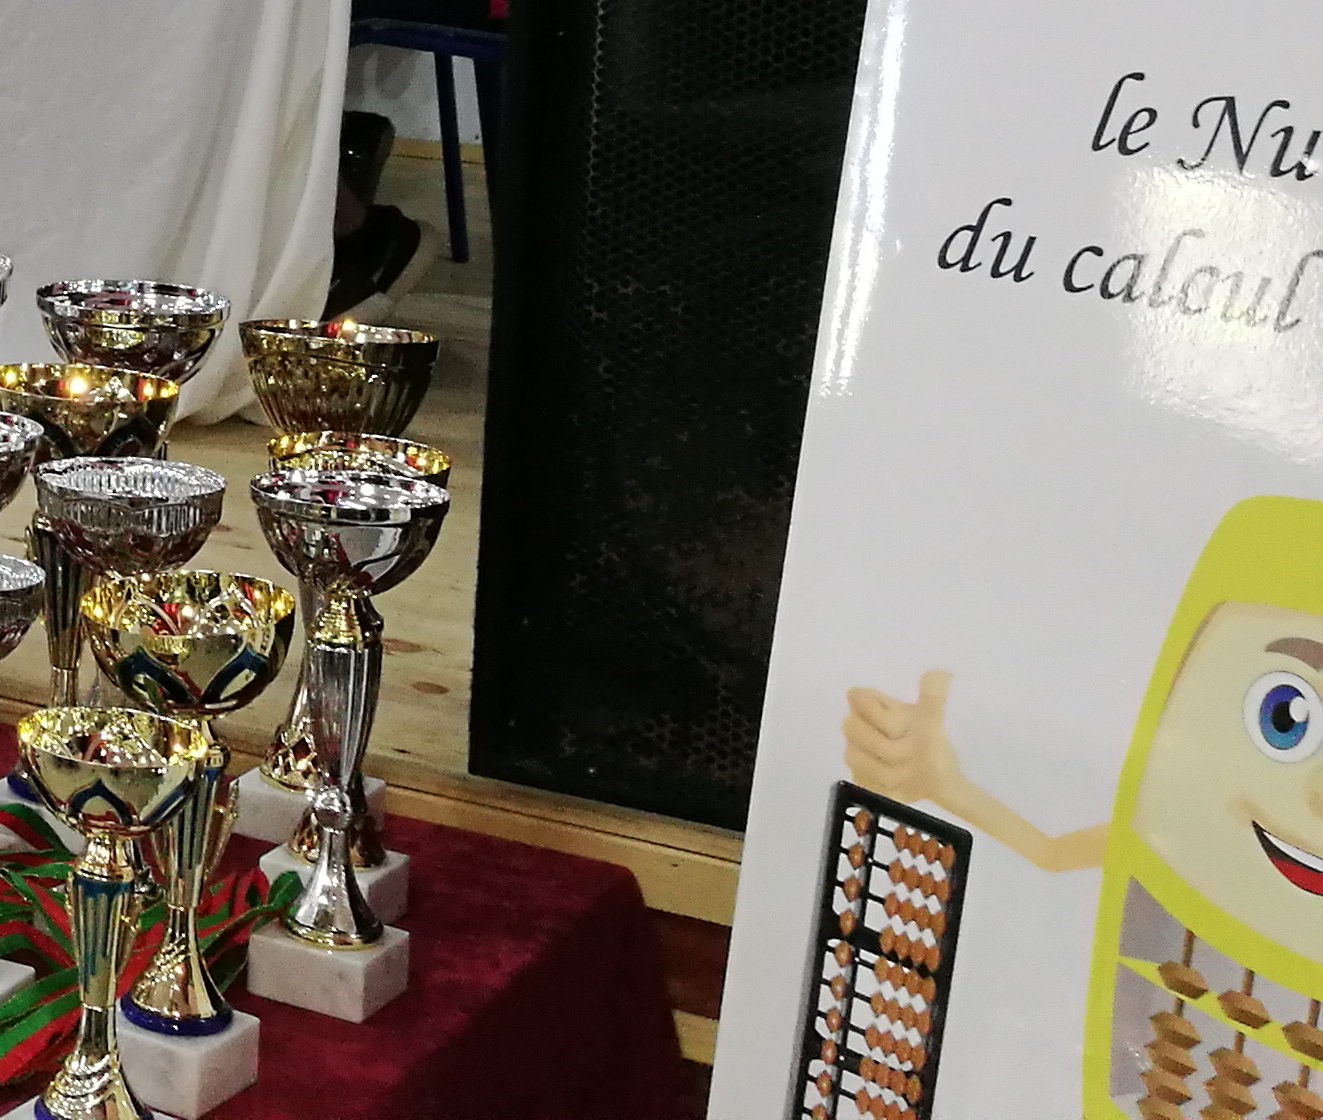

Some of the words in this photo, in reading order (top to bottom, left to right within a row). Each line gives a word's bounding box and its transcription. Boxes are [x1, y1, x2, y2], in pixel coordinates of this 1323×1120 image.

[1091, 71, 1158, 156] le
[1177, 95, 1322, 181] Nu
[937, 197, 1037, 283] du
[1063, 228, 1323, 333] calcul
